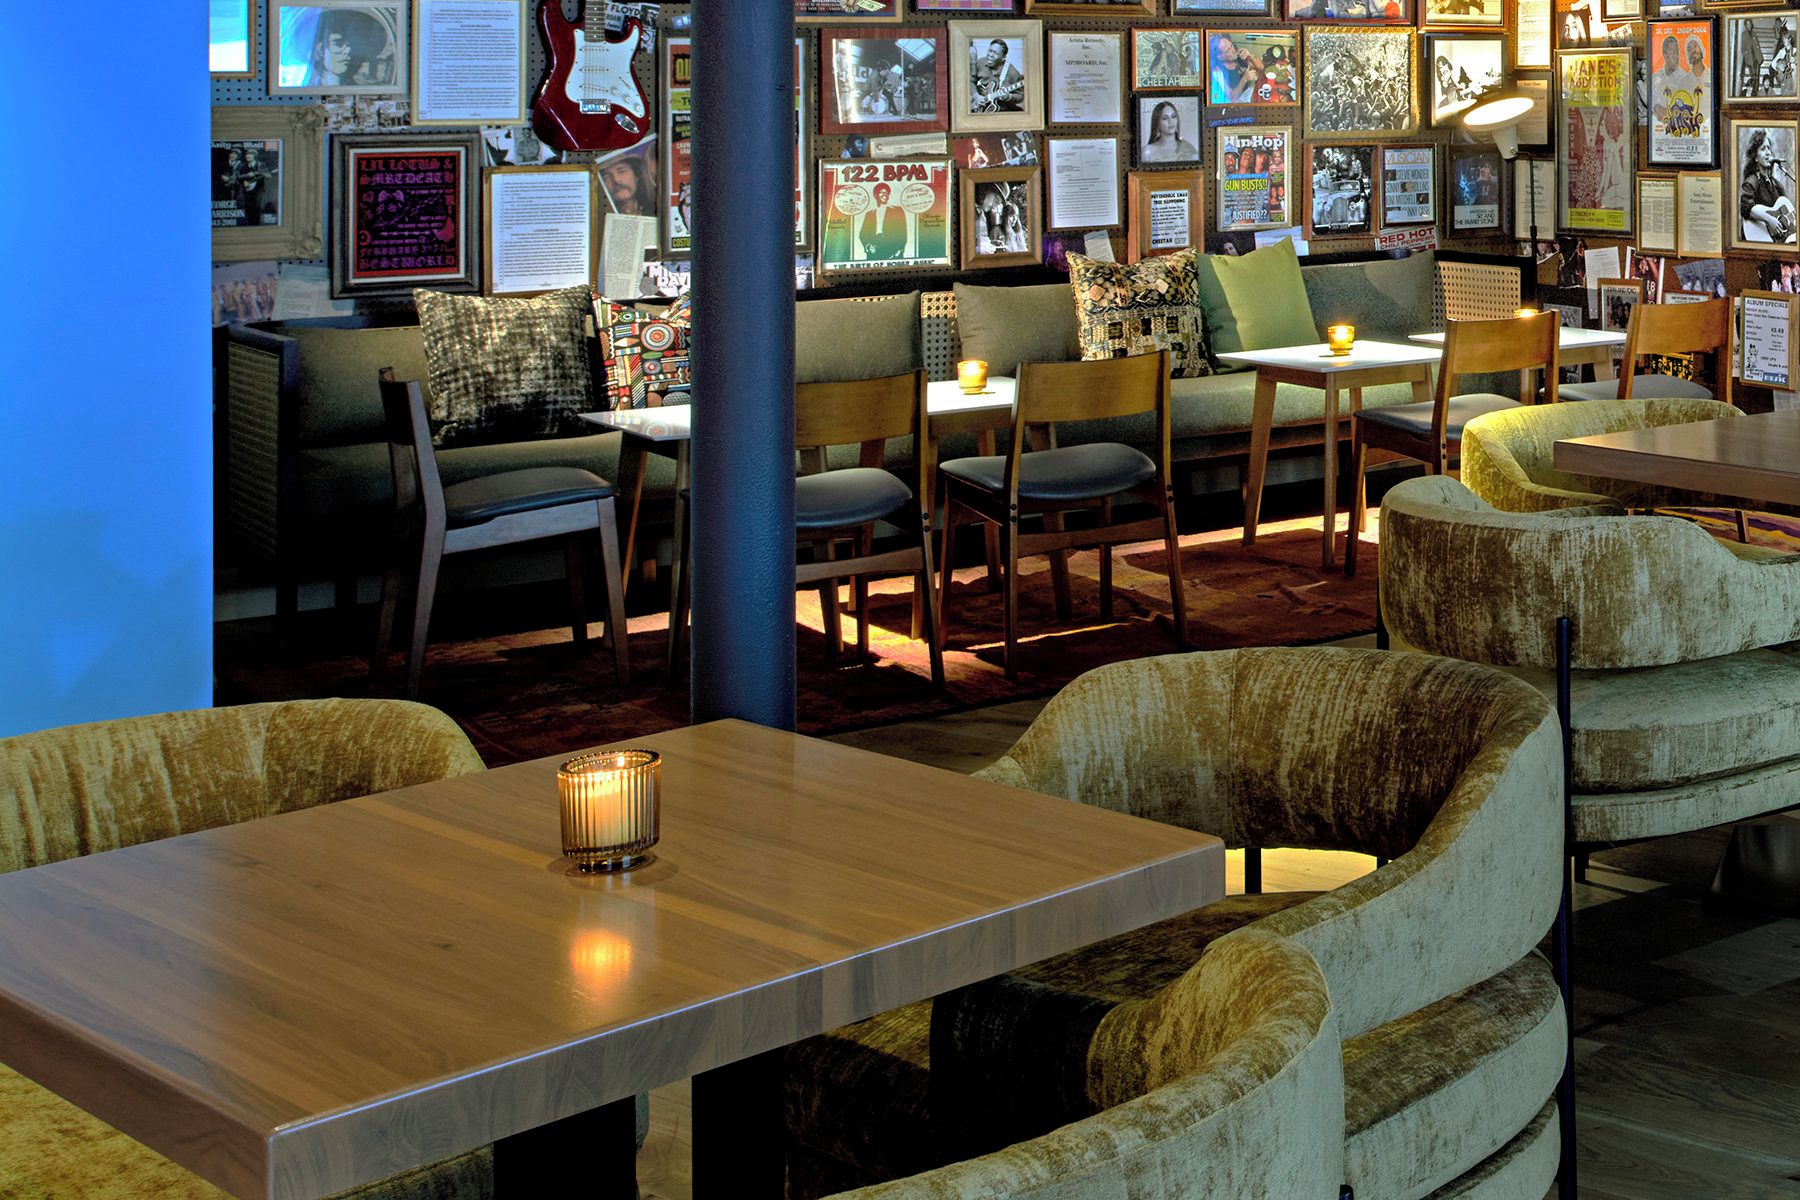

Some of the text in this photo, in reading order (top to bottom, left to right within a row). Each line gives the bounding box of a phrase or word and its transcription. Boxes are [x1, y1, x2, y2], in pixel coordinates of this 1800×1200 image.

[611, 4, 640, 16] FLOYD
[1573, 59, 1617, 75] JANE'S
[1141, 77, 1179, 87] CHEETAH
[1569, 77, 1620, 88] ADDICTION
[842, 164, 928, 182] 122 BPM
[1224, 178, 1268, 191] GUN BUSTS!!
[212, 200, 237, 209] EORGE
[212, 209, 246, 218] ARRISON
[1232, 209, 1268, 220] JUSTIFIED??
[1380, 227, 1435, 244] RED HOT
[1380, 235, 1435, 249] CHILI PEPPERS
